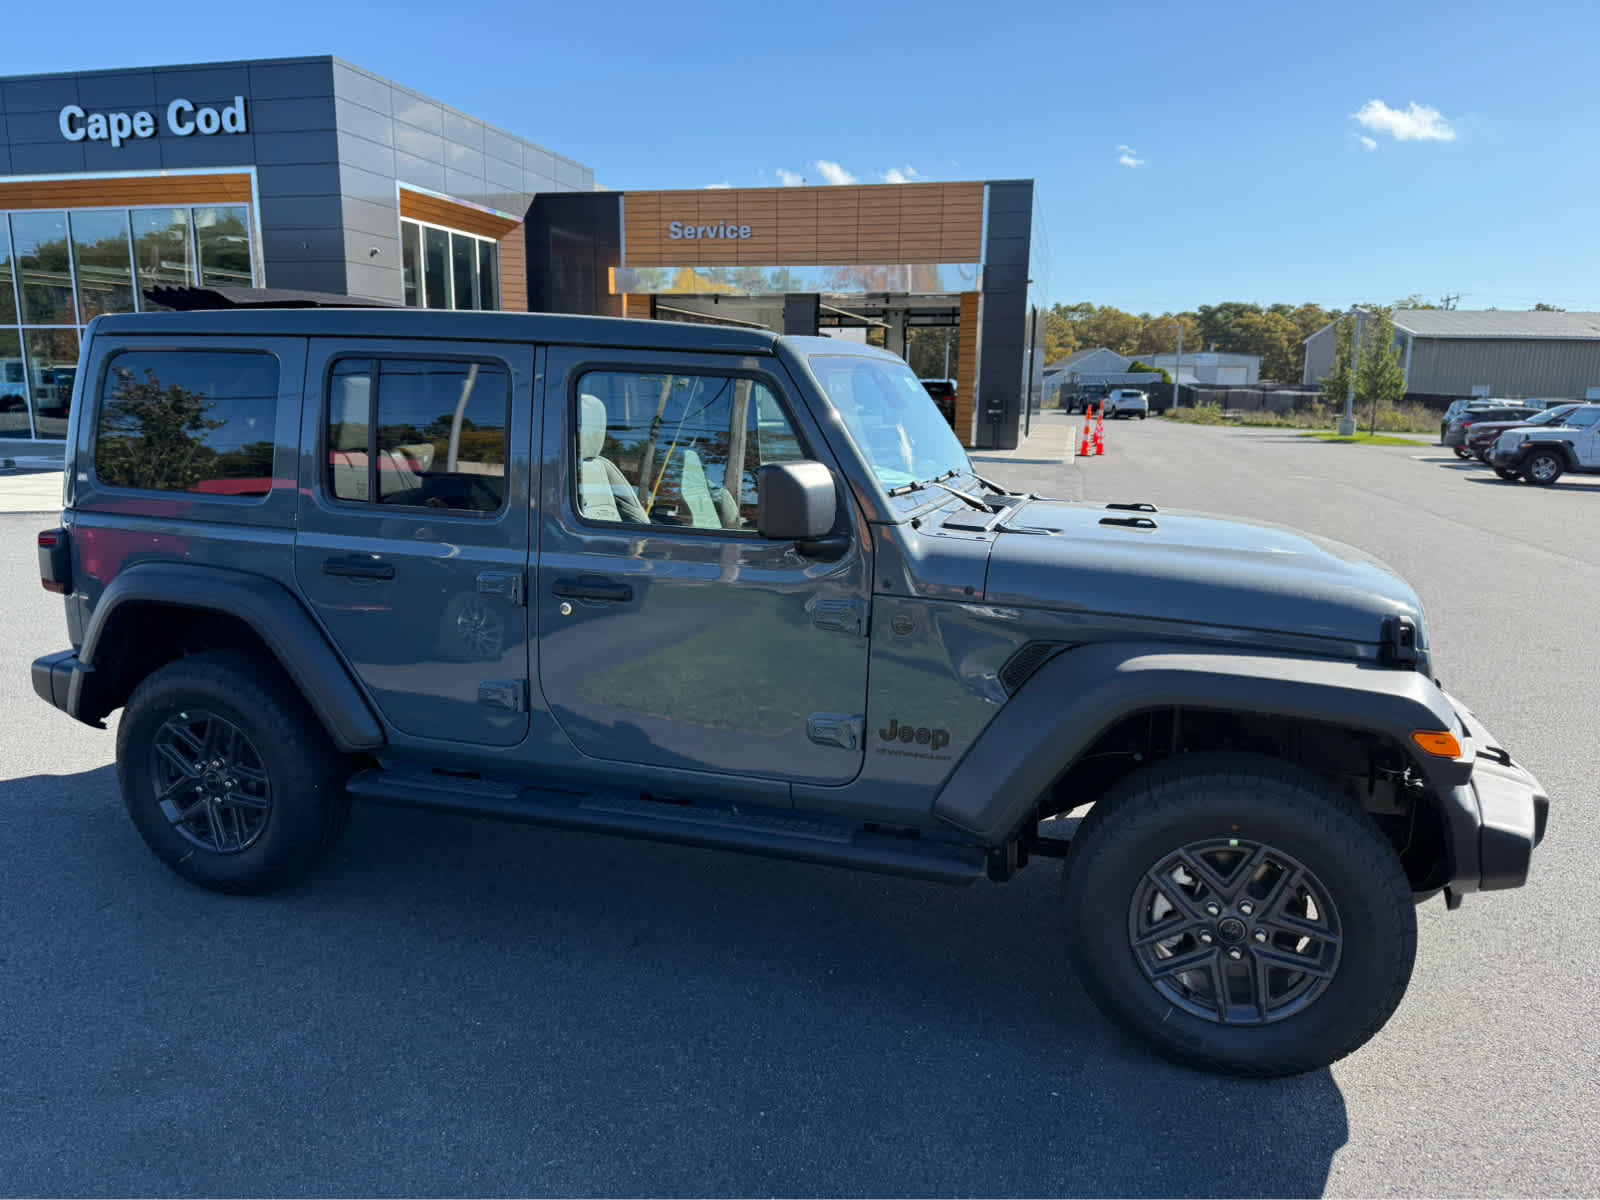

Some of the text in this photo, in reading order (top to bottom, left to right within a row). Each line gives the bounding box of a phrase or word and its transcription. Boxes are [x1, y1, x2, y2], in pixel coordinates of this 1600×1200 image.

[59, 96, 248, 147] Cape Cod
[669, 220, 752, 239] Service
[879, 719, 950, 751] Jeep
